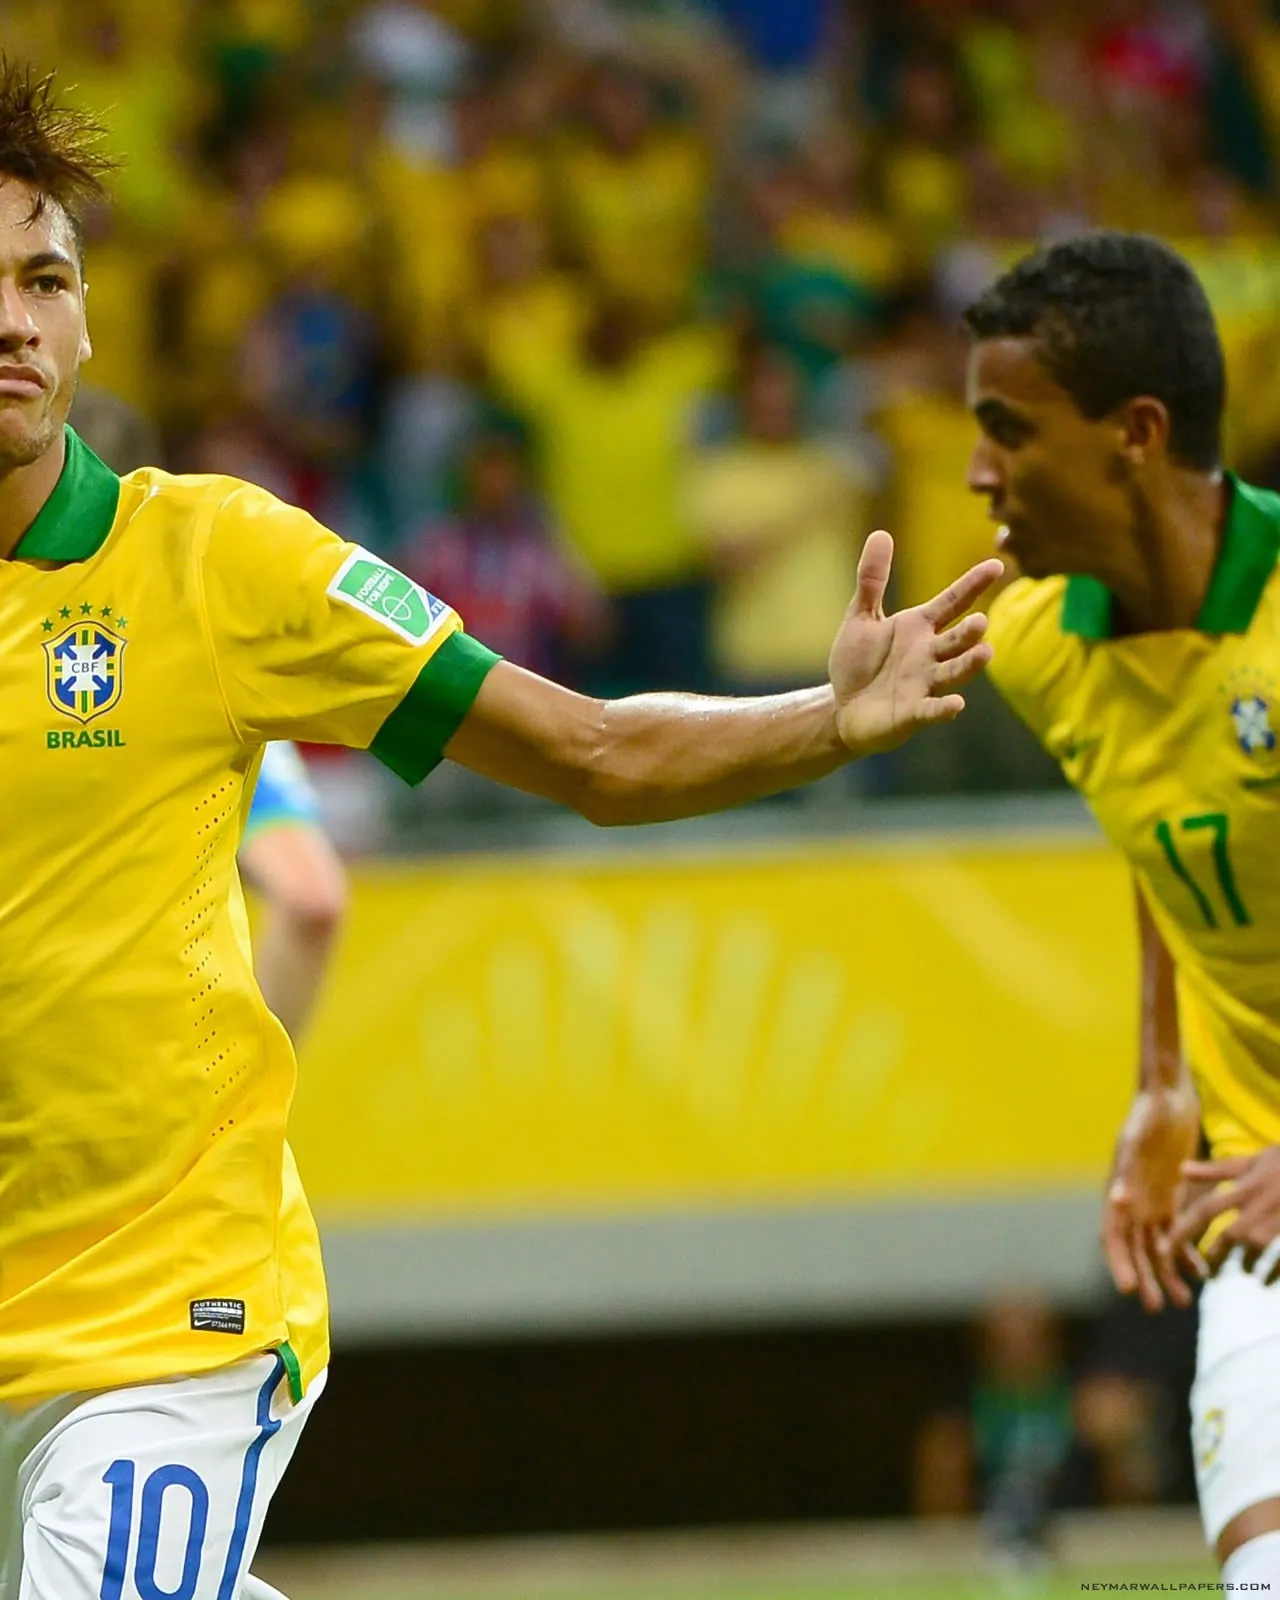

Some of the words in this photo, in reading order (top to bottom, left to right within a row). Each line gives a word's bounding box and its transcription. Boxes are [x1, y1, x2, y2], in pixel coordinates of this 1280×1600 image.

[71, 661, 99, 674] CBF
[46, 730, 126, 750] BRASIL
[1155, 813, 1251, 930] 17
[193, 1301, 242, 1310] AUTHENTIC
[99, 1459, 209, 1600] 10
